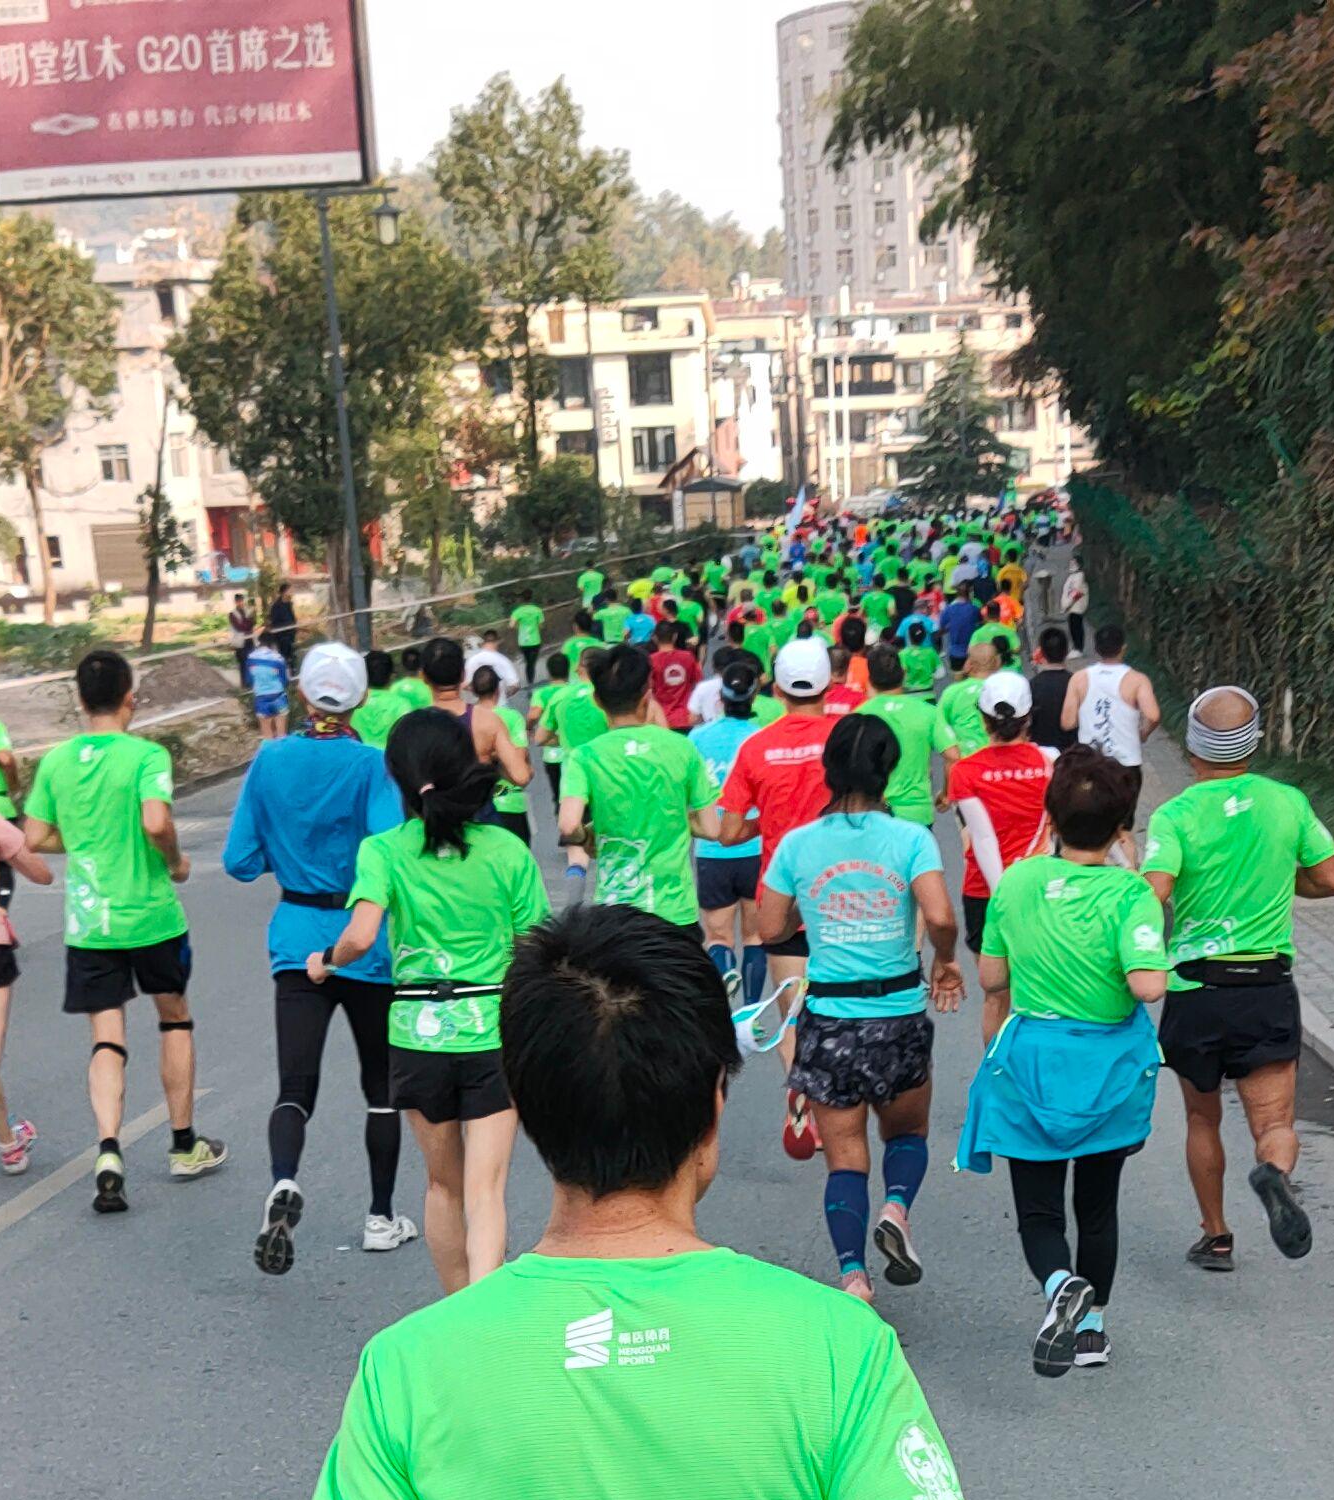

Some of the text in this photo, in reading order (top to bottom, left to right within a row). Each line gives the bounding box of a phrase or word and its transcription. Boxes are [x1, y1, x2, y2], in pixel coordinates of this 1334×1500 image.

[138, 23, 335, 75] G20首席之选
[618, 1355, 655, 1366] SPORTS
